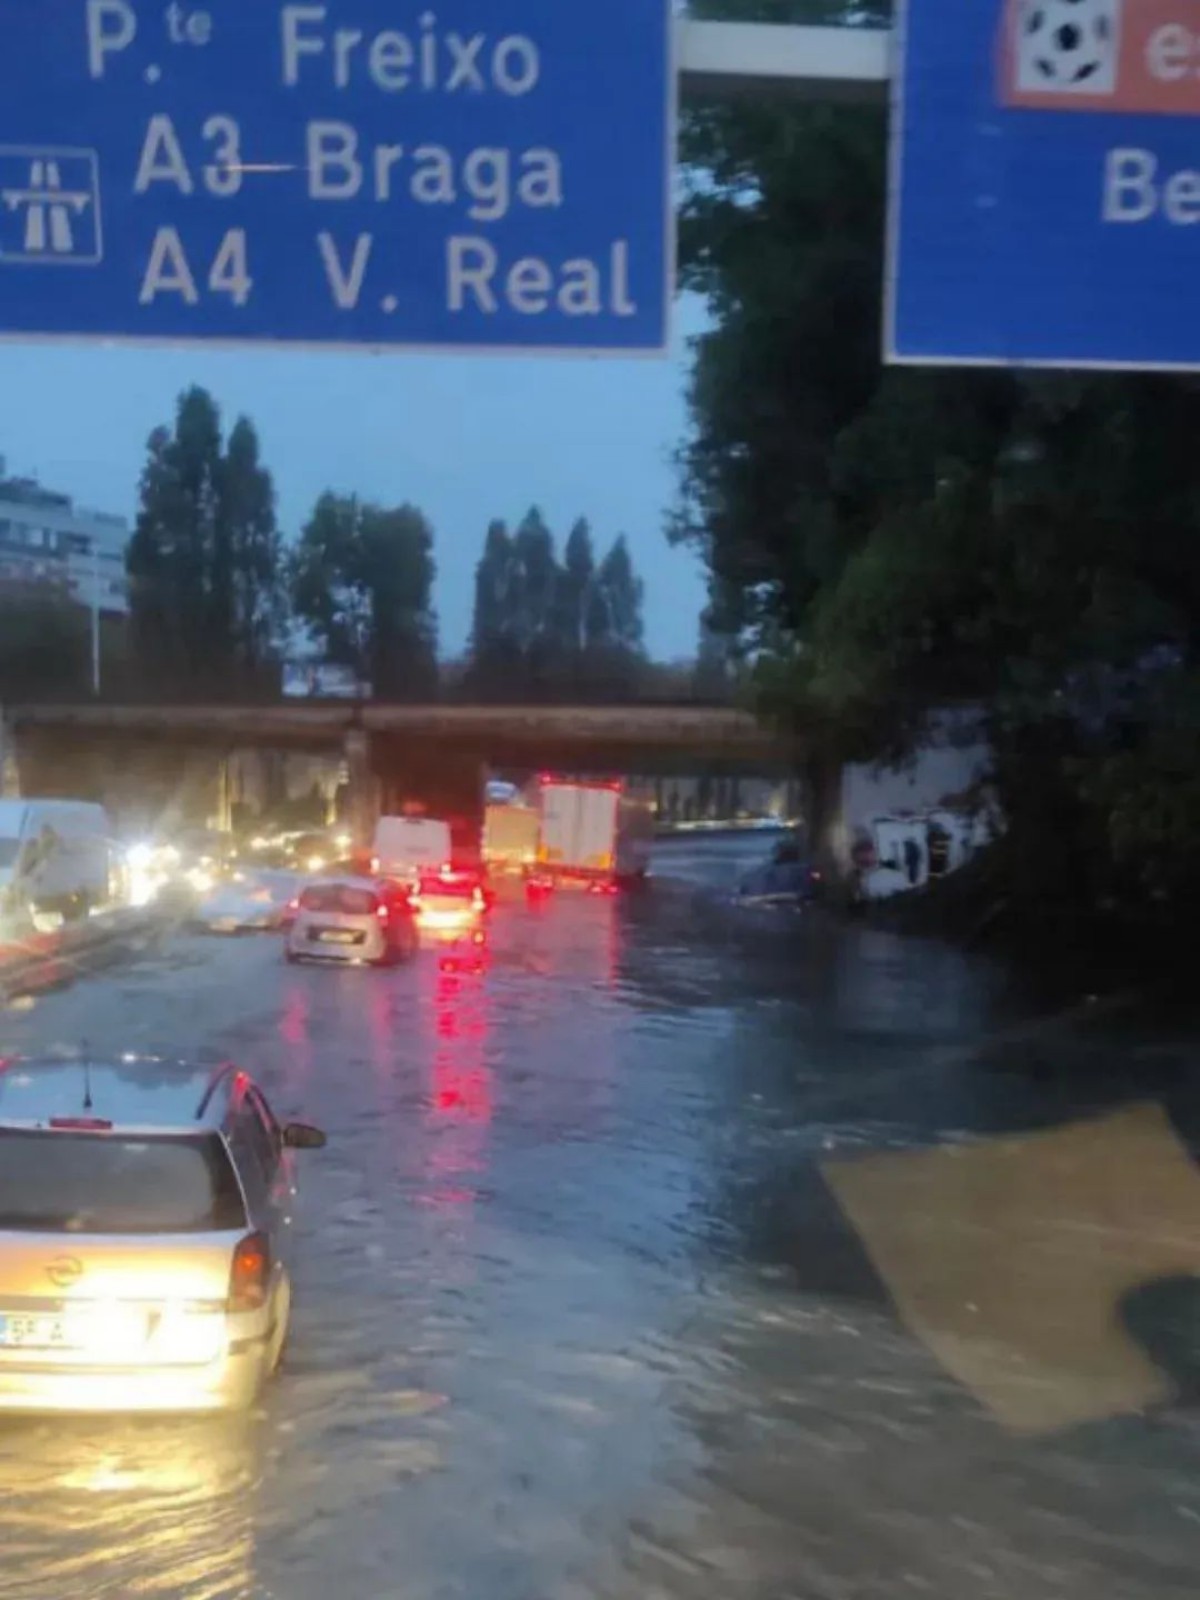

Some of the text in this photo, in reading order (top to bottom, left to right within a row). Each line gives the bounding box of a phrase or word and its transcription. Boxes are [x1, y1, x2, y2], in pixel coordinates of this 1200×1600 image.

[281, 5, 540, 96] Freixo
[1146, 22, 1200, 82] e
[134, 114, 563, 221] A3 Braga
[139, 226, 637, 317] A4 V. Real
